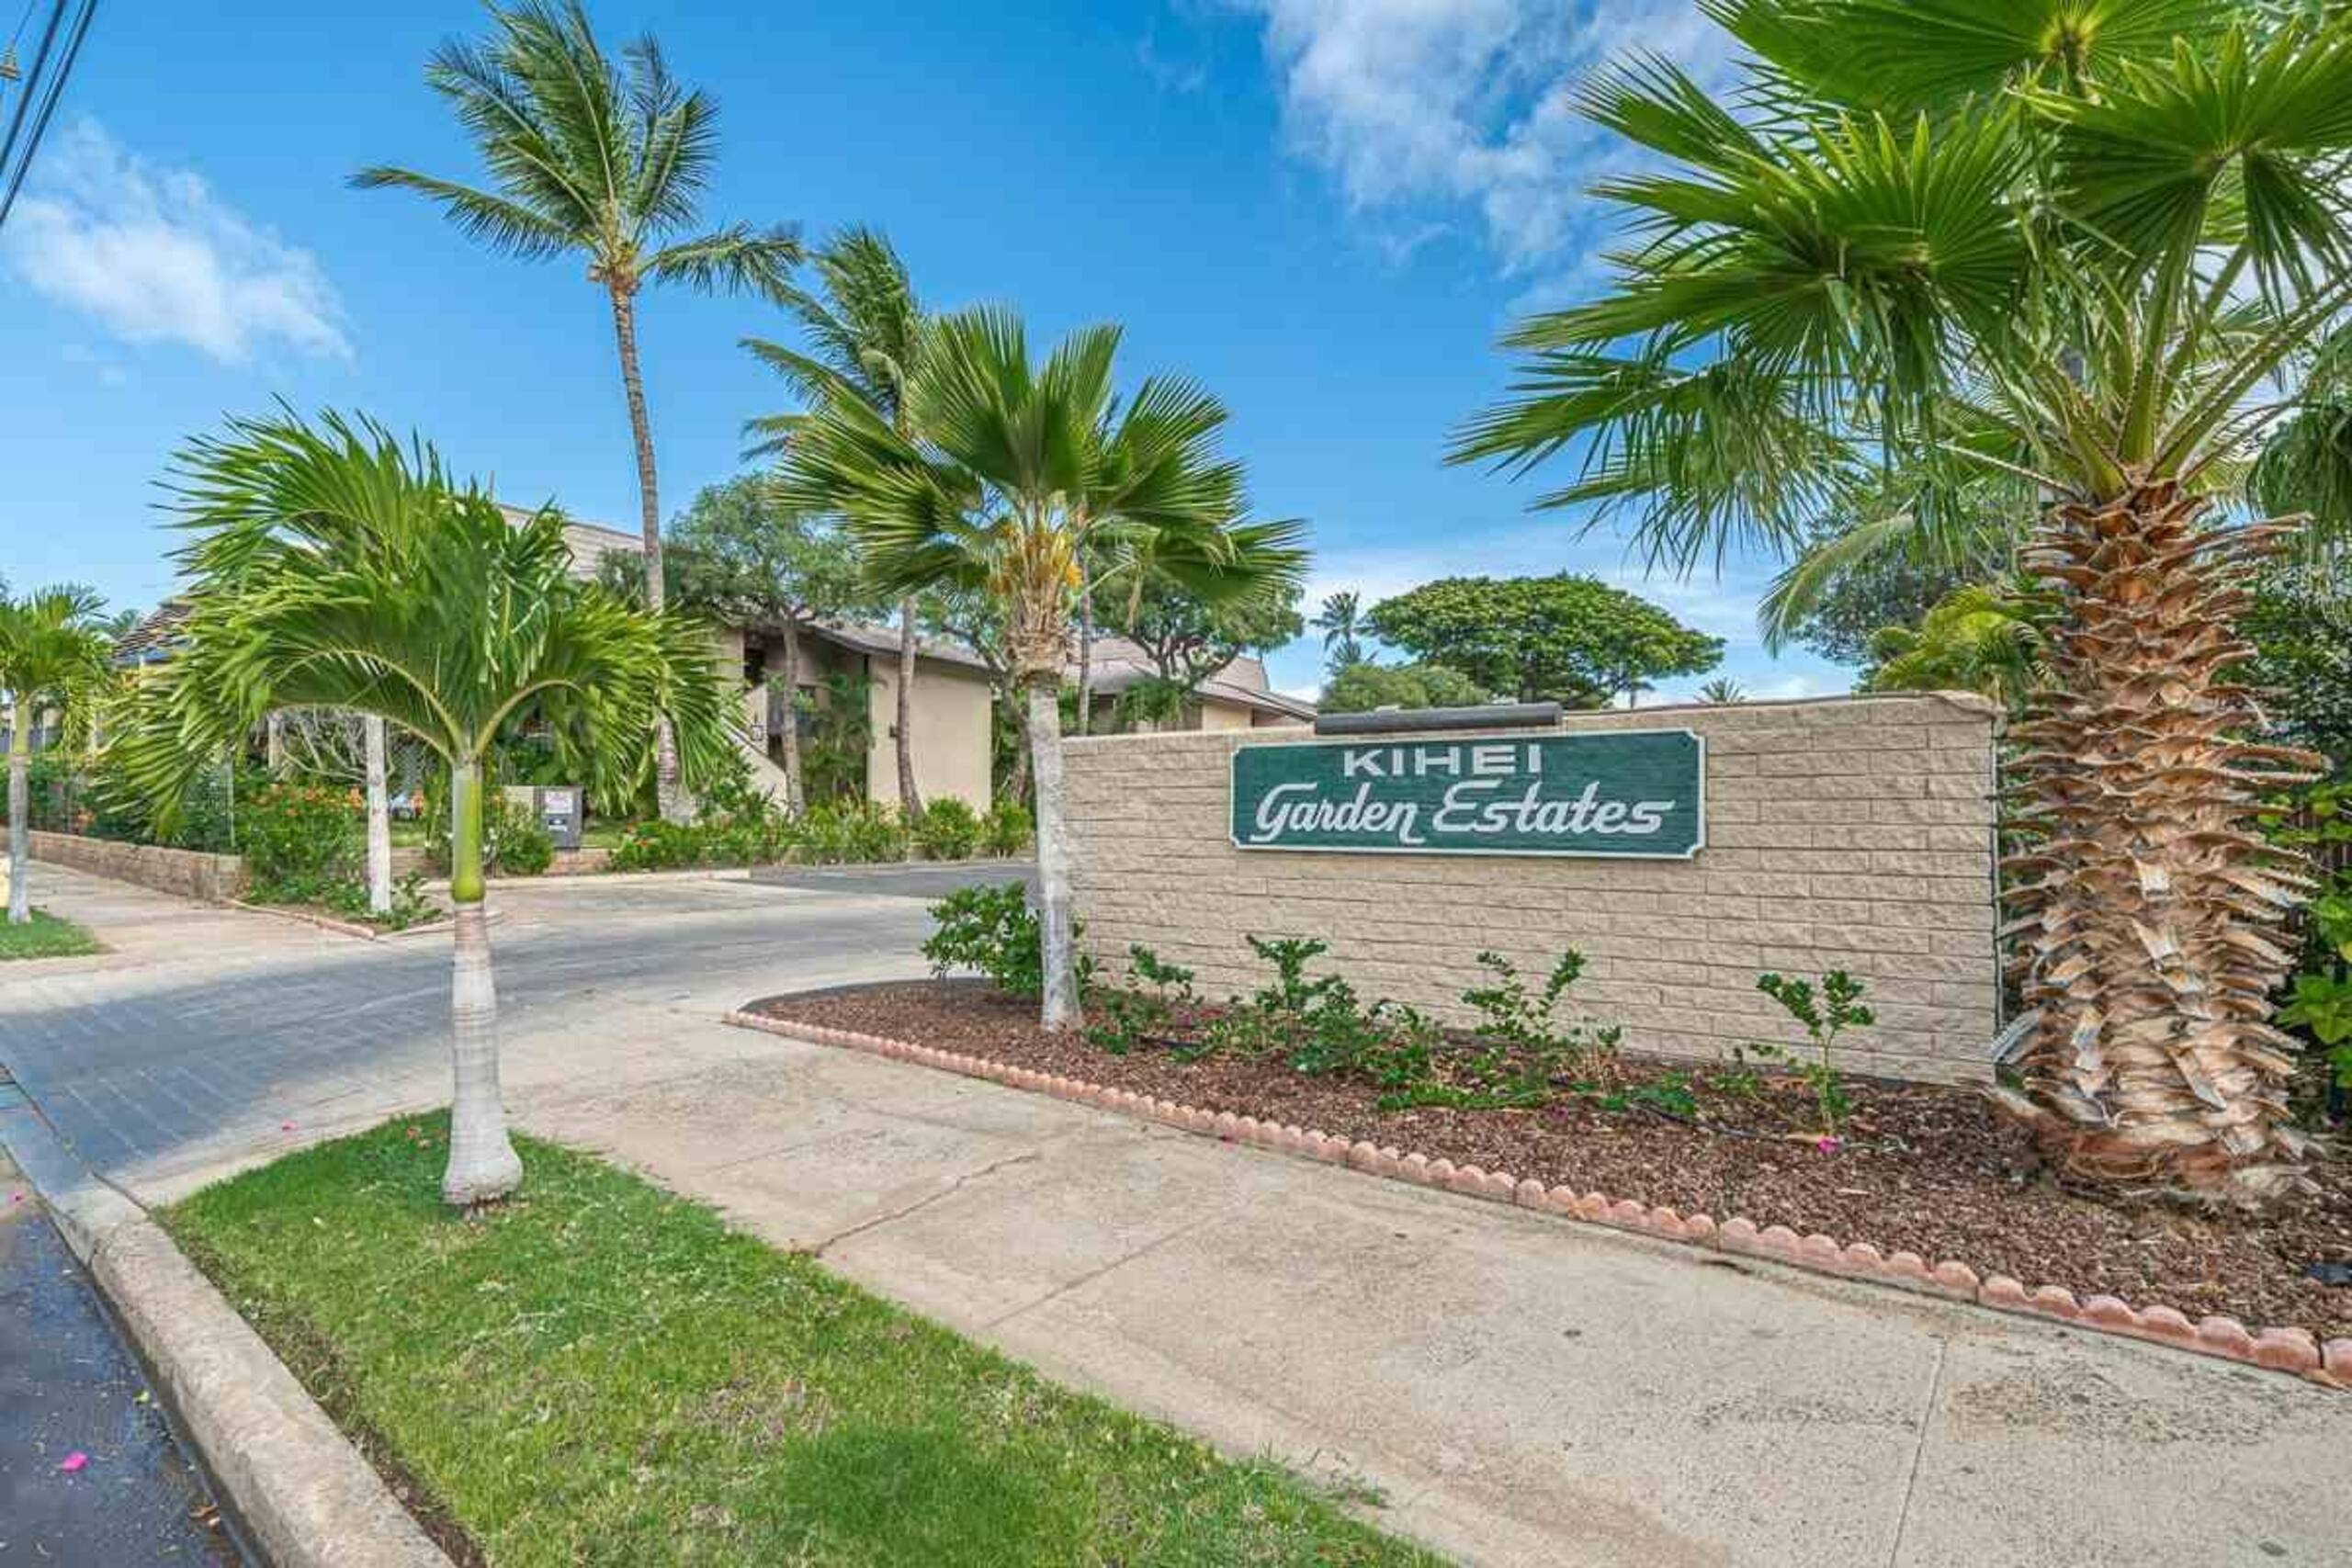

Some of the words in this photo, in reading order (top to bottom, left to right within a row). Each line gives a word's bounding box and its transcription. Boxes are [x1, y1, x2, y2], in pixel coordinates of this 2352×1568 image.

[1343, 744, 1542, 777] KIHEI
[1250, 782, 1425, 844] Garden
[1432, 779, 1675, 834] Estates
